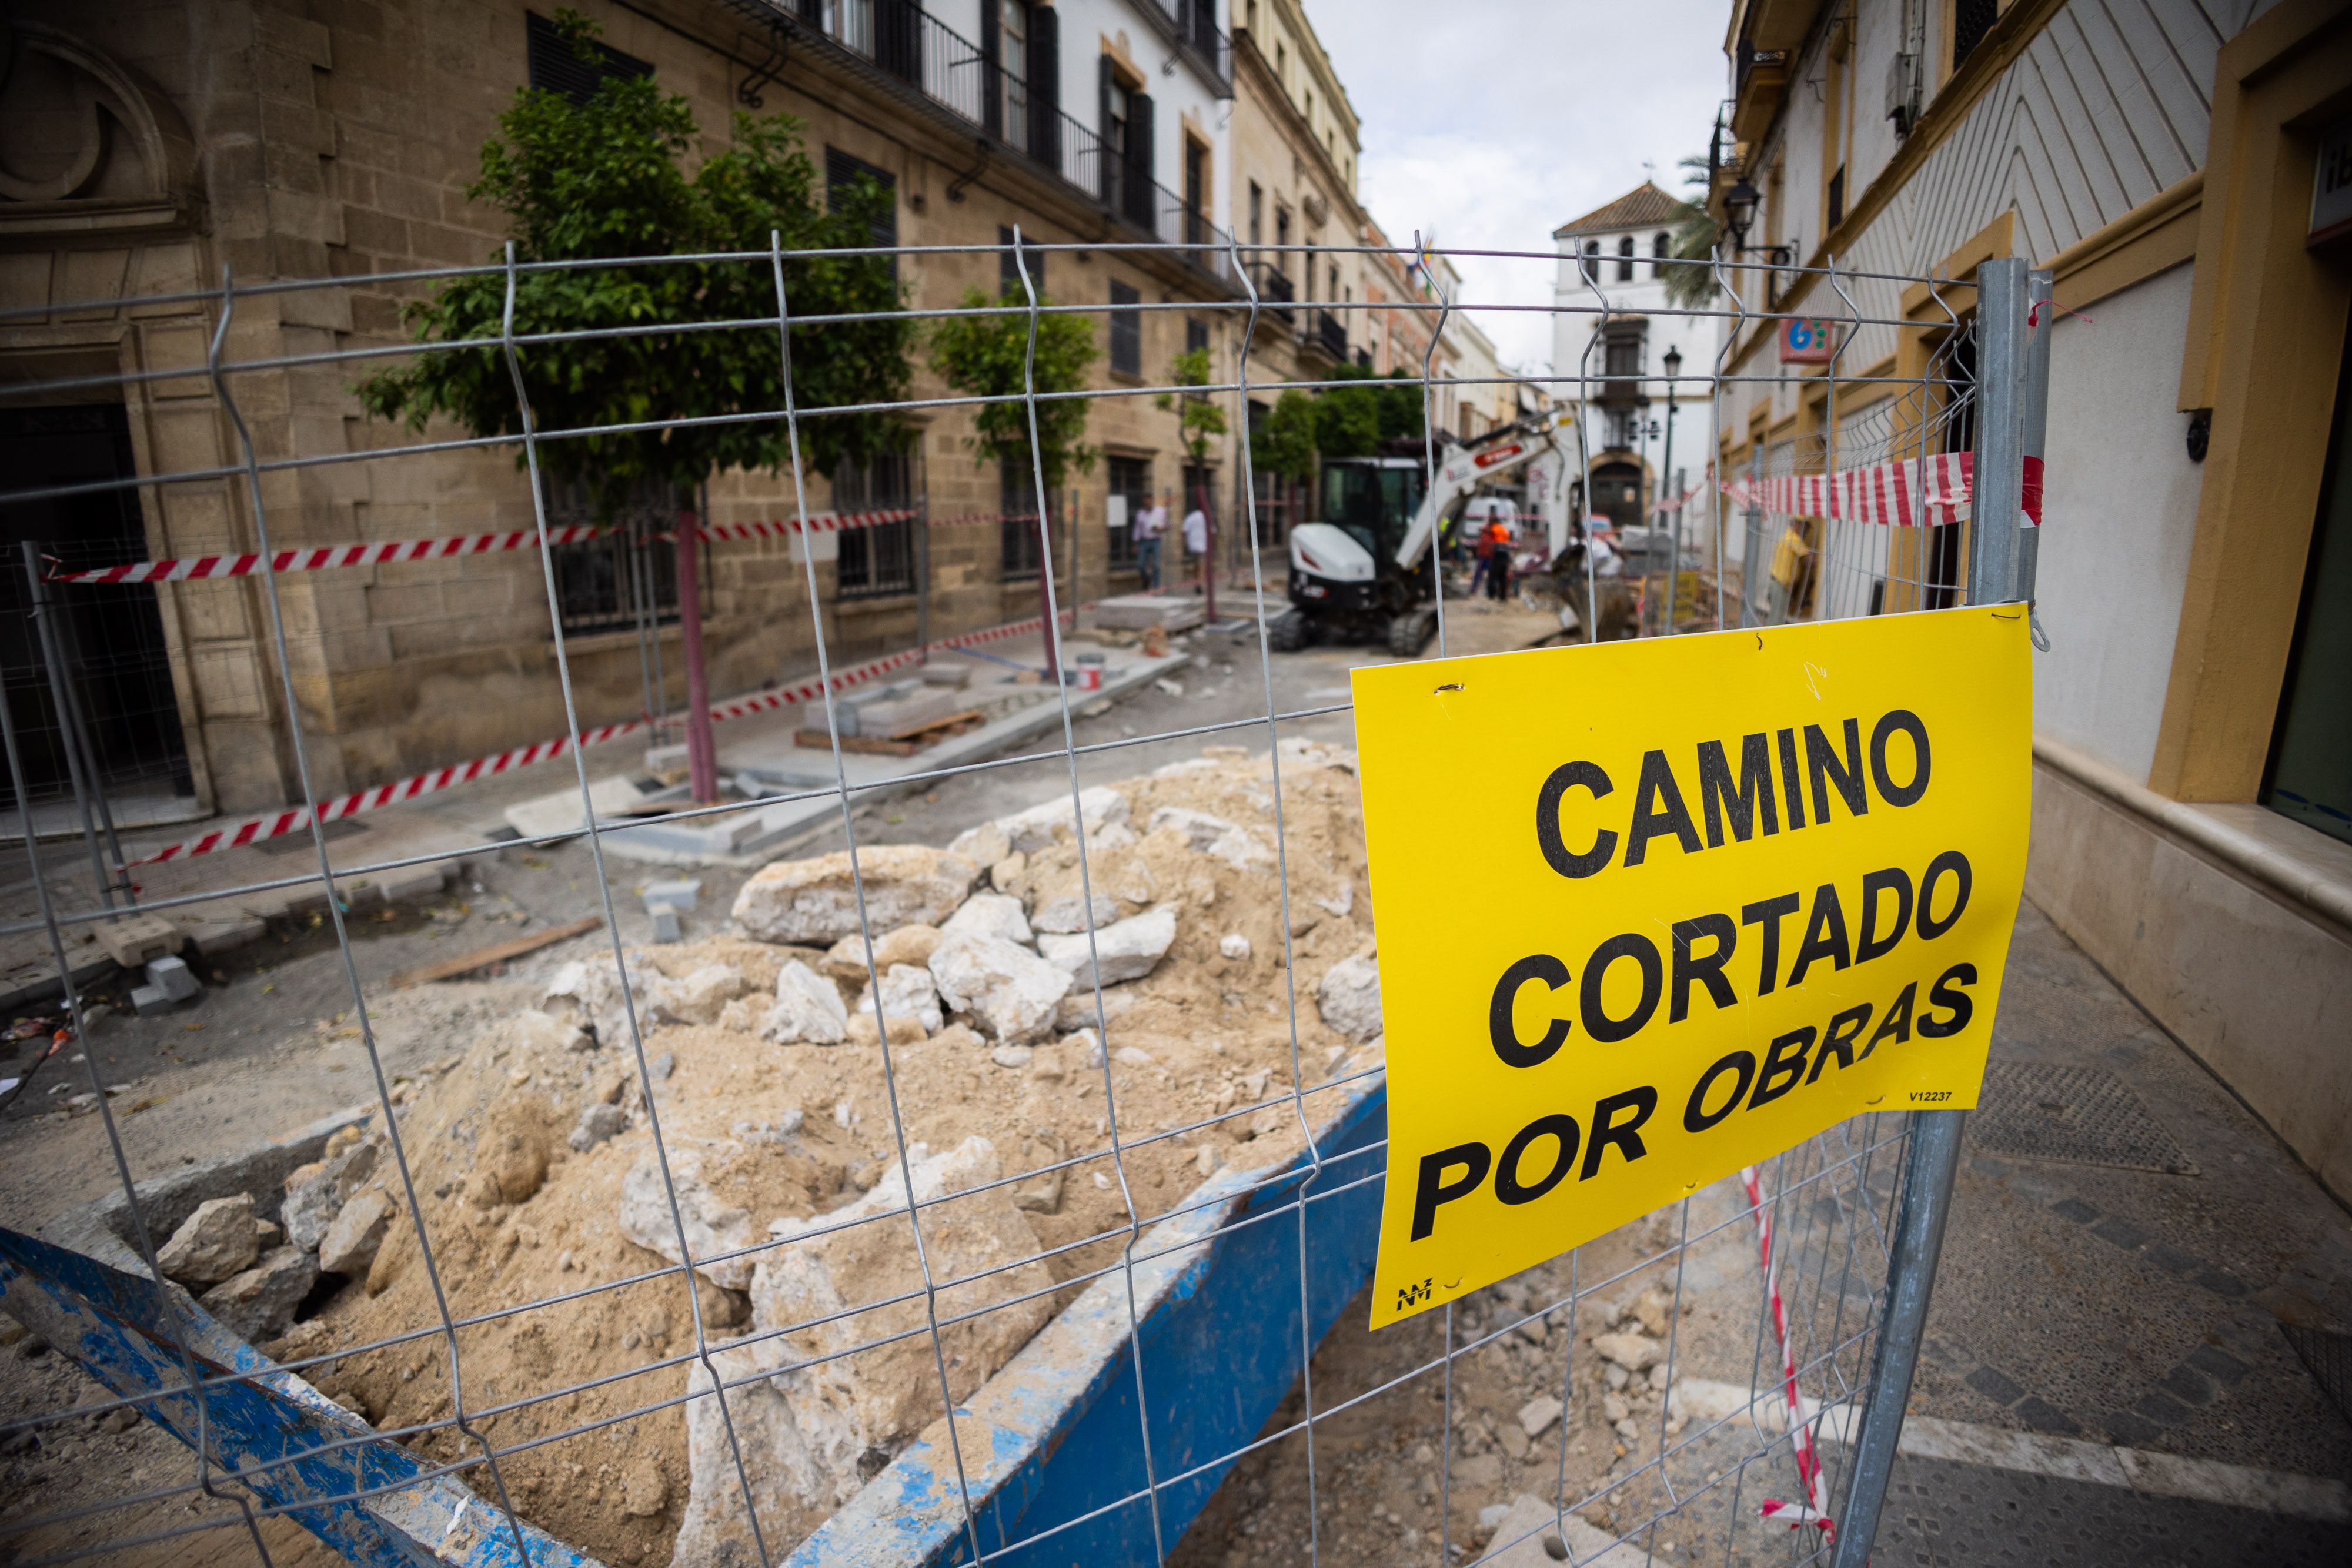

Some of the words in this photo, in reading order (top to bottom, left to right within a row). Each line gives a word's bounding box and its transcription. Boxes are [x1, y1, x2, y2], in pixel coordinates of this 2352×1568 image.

[1535, 708, 1932, 879] CAMINO
[1489, 850, 1973, 1068] CORTADO
[1410, 1085, 1658, 1243] POR
[1682, 962, 1979, 1134] OBRAS
[1910, 1092, 1952, 1102] V12237
